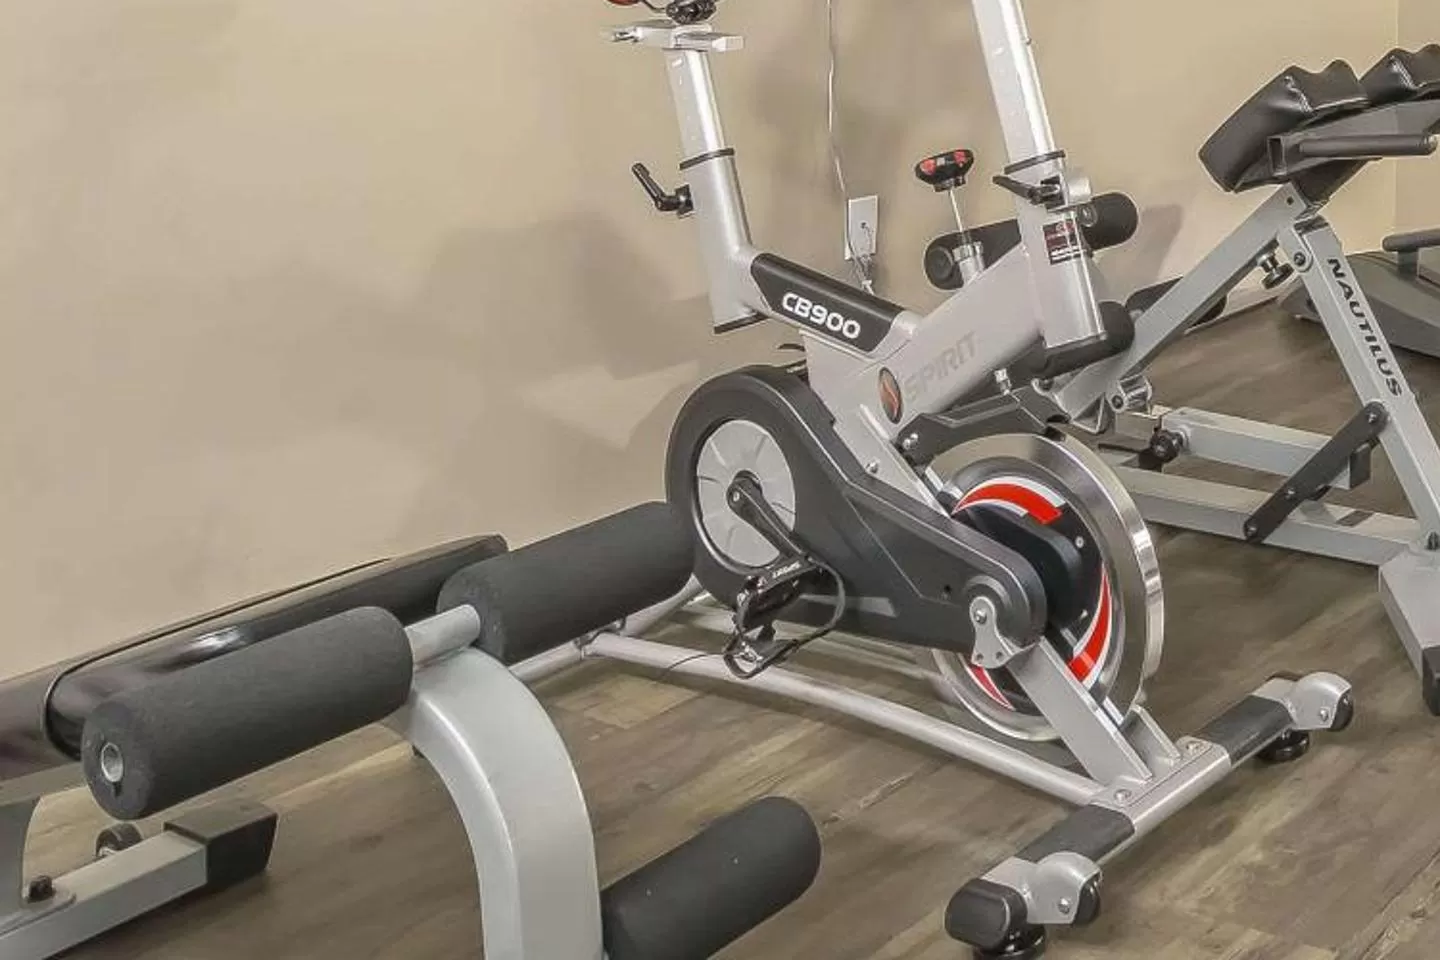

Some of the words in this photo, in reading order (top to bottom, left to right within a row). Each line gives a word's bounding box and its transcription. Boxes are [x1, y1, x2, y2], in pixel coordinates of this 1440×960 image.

[782, 292, 861, 339] CB900
[1327, 257, 1403, 397] NAUTILUS
[904, 330, 977, 402] SPIRIT
